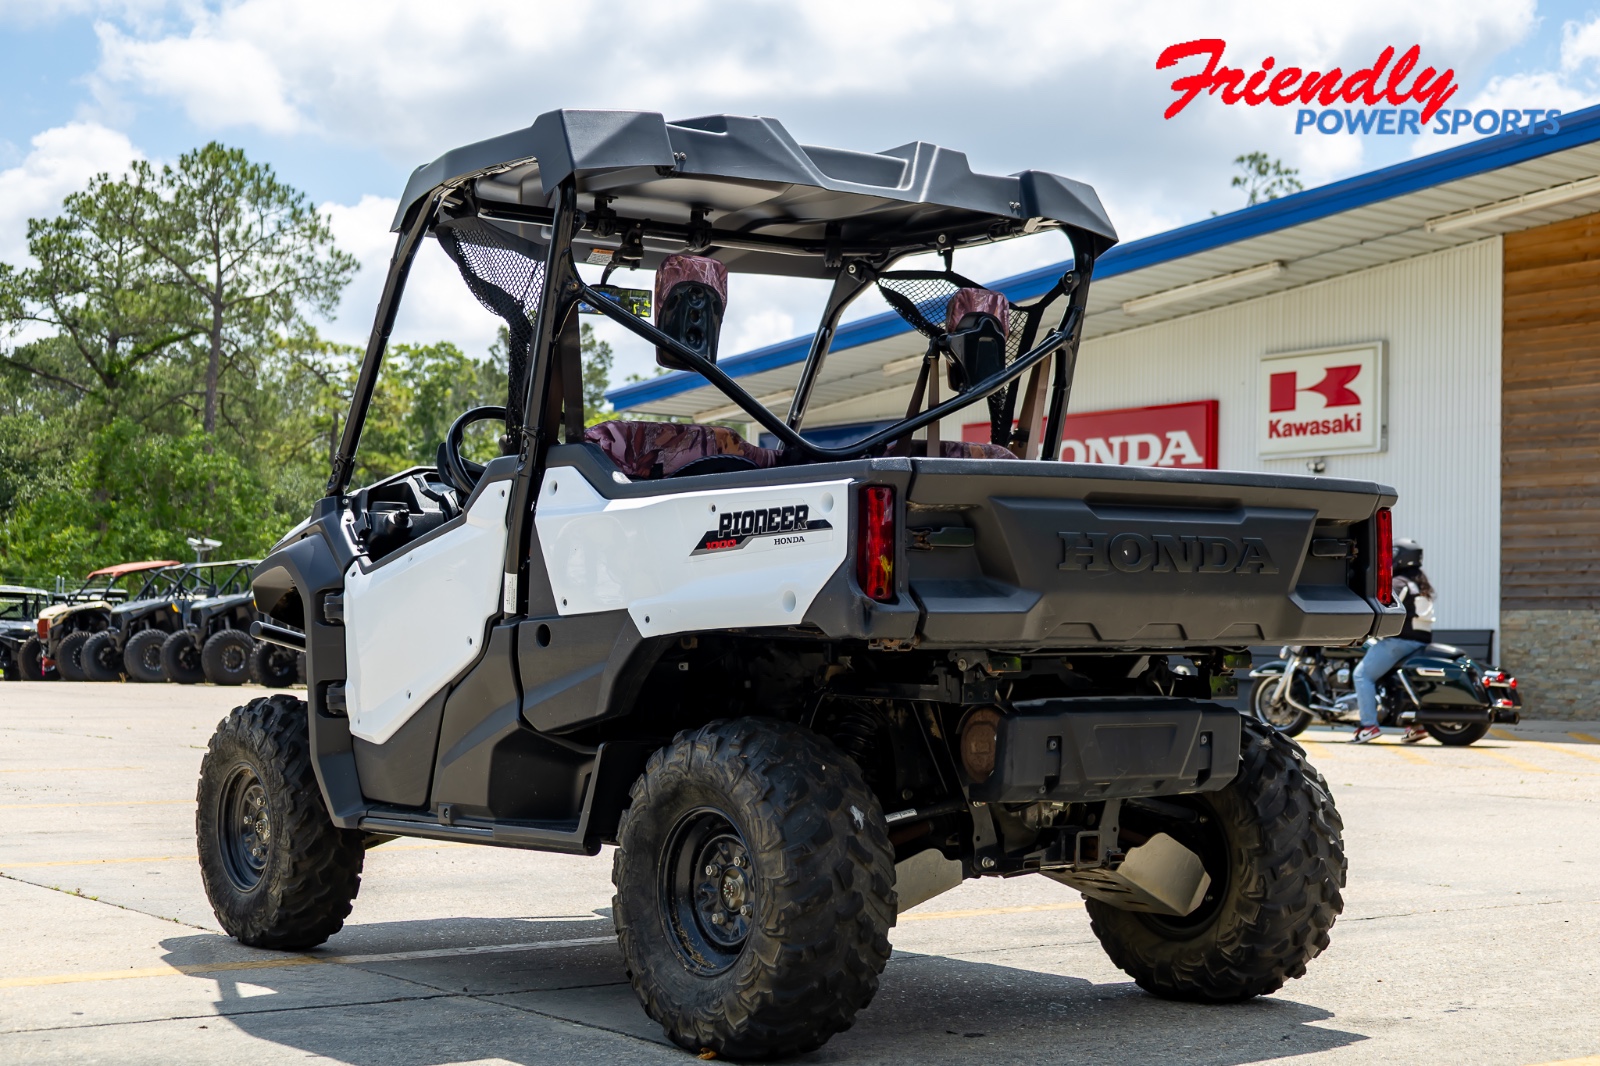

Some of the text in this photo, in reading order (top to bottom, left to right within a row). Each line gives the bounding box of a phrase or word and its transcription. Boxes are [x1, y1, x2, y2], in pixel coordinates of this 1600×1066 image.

[1269, 412, 1362, 439] Kawasaki
[1037, 430, 1203, 466] ONDA
[718, 504, 809, 538] PIONEER
[705, 539, 737, 550] 1000
[774, 536, 805, 546] HONDA
[1058, 531, 1279, 574] HONDA
